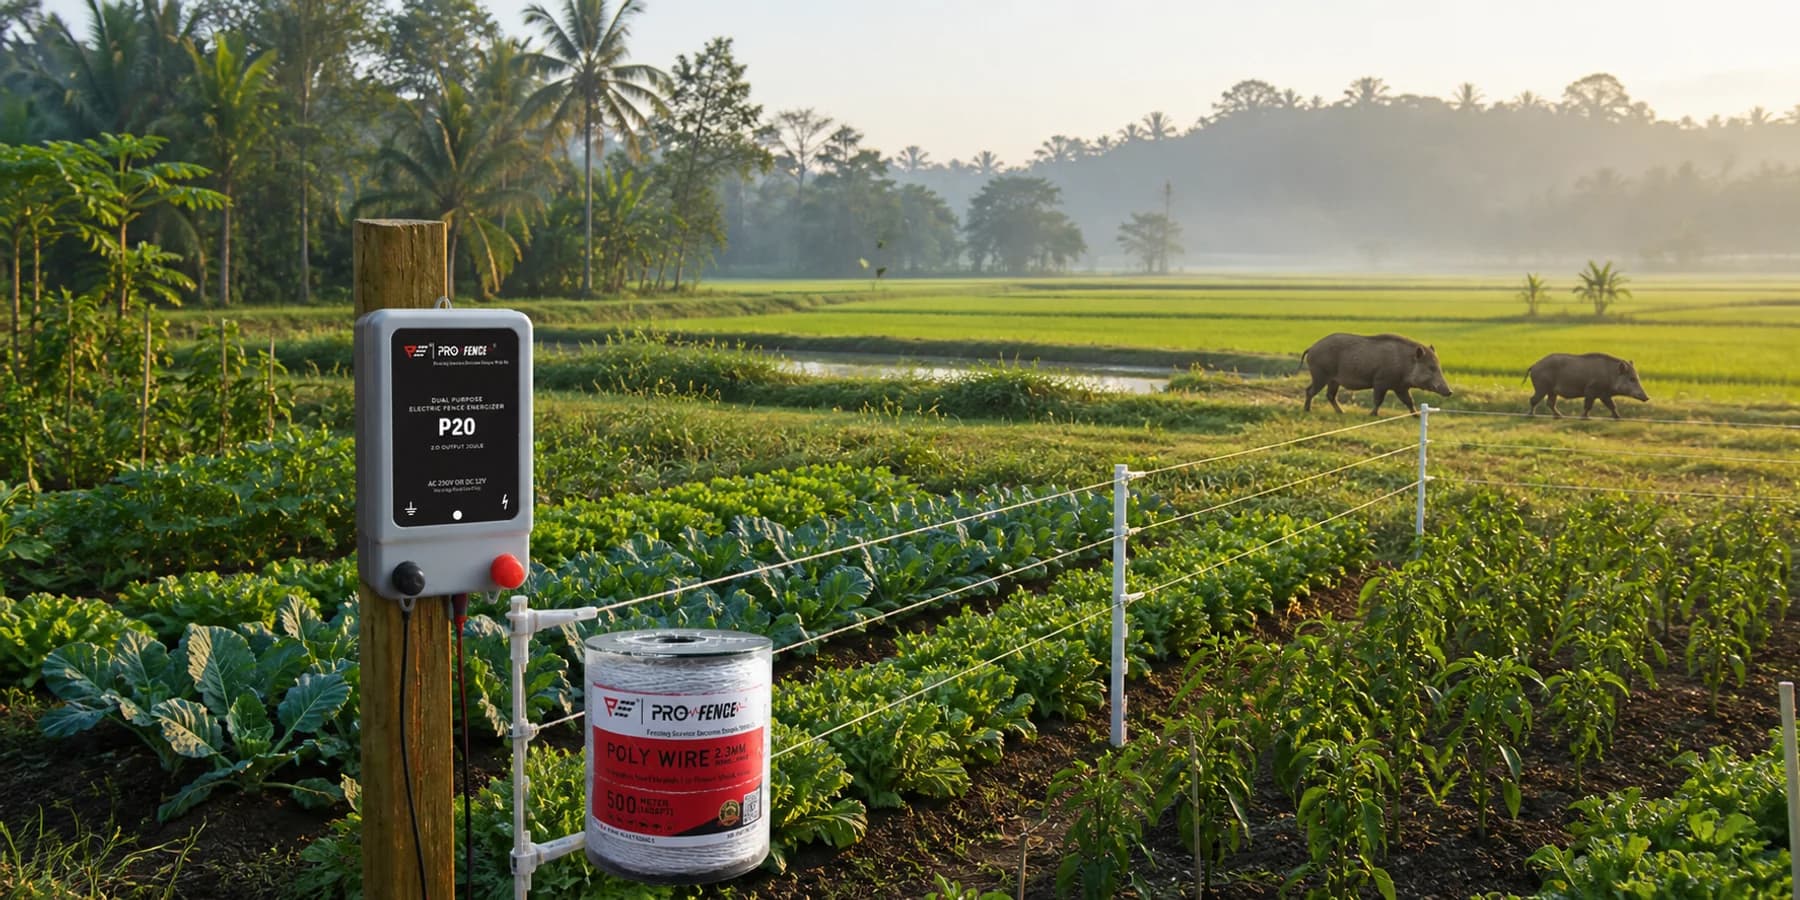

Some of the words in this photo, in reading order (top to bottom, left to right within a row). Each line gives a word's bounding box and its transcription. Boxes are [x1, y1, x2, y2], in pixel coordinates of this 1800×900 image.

[438, 345, 459, 356] PRO
[463, 345, 487, 356] FENCE
[439, 417, 476, 436] P20
[652, 704, 688, 721] PRO
[698, 702, 737, 721] FENCE
[607, 742, 650, 767] POLY
[658, 749, 710, 768] WIRE
[714, 743, 746, 759] 2.3MM
[607, 790, 637, 814] 500
